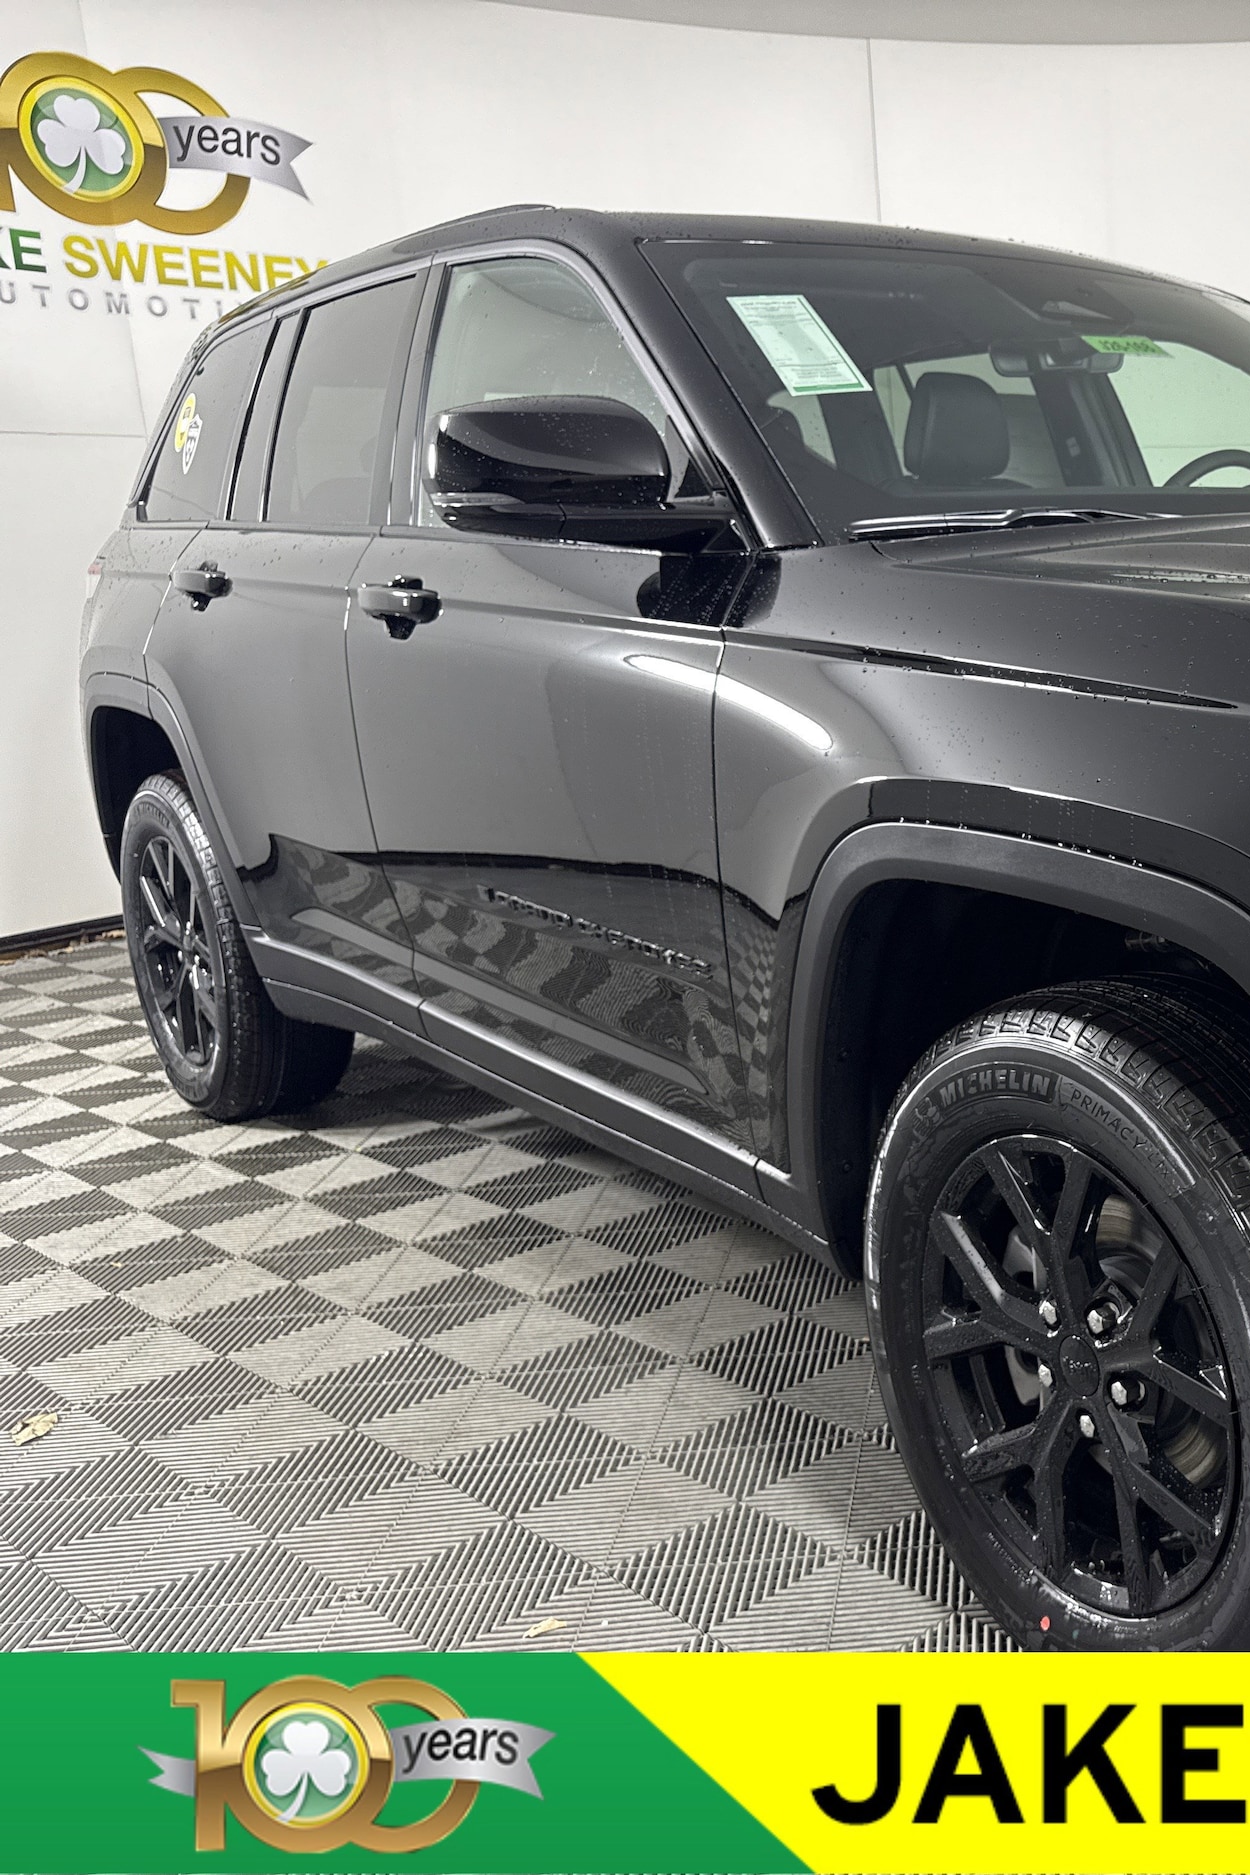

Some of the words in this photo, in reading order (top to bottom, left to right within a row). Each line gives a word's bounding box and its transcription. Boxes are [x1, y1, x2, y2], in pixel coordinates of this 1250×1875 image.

[173, 121, 281, 166] years
[940, 1069, 1051, 1109] MICHELIN
[1070, 1088, 1148, 1149] PRIMACY
